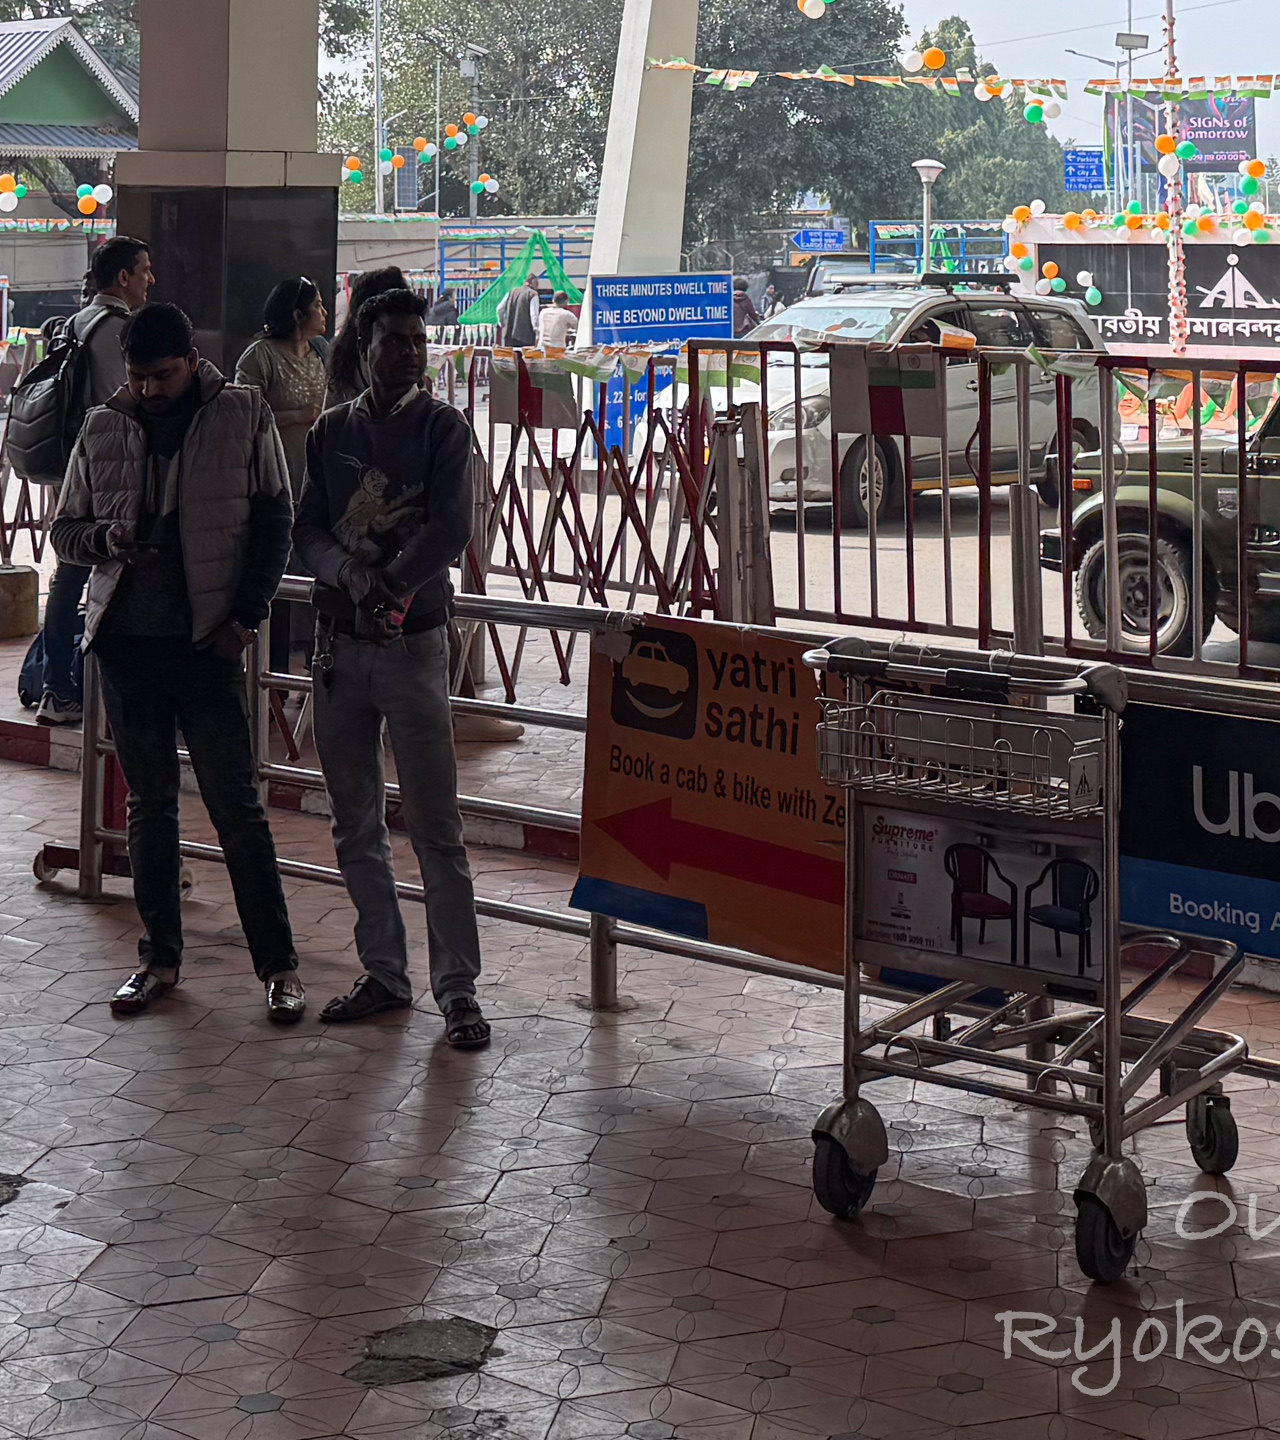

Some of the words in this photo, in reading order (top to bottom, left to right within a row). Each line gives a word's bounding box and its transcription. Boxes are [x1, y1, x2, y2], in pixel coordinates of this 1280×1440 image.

[1189, 116, 1230, 128] SIGNs
[1233, 116, 1248, 128] of
[596, 284, 629, 298] THREE
[631, 283, 671, 297] MINUTES
[674, 282, 706, 296] DWELL
[707, 281, 728, 294] TIME
[596, 310, 621, 325] FINE
[623, 308, 666, 324] BEYOND
[668, 307, 704, 321] DWELL
[705, 306, 728, 320] TIME
[1089, 308, 1162, 337] ারতীয়
[705, 647, 797, 699] yatri
[704, 701, 801, 756] sathi
[609, 744, 655, 783] Book
[660, 765, 671, 786] a
[675, 764, 708, 795] cab
[713, 768, 727, 800] &
[732, 771, 771, 810] bike
[777, 786, 818, 822] with
[821, 794, 846, 829] Ze
[872, 815, 935, 842] Supreme
[872, 835, 934, 853] FURNITURE
[1169, 892, 1261, 934] Booking
